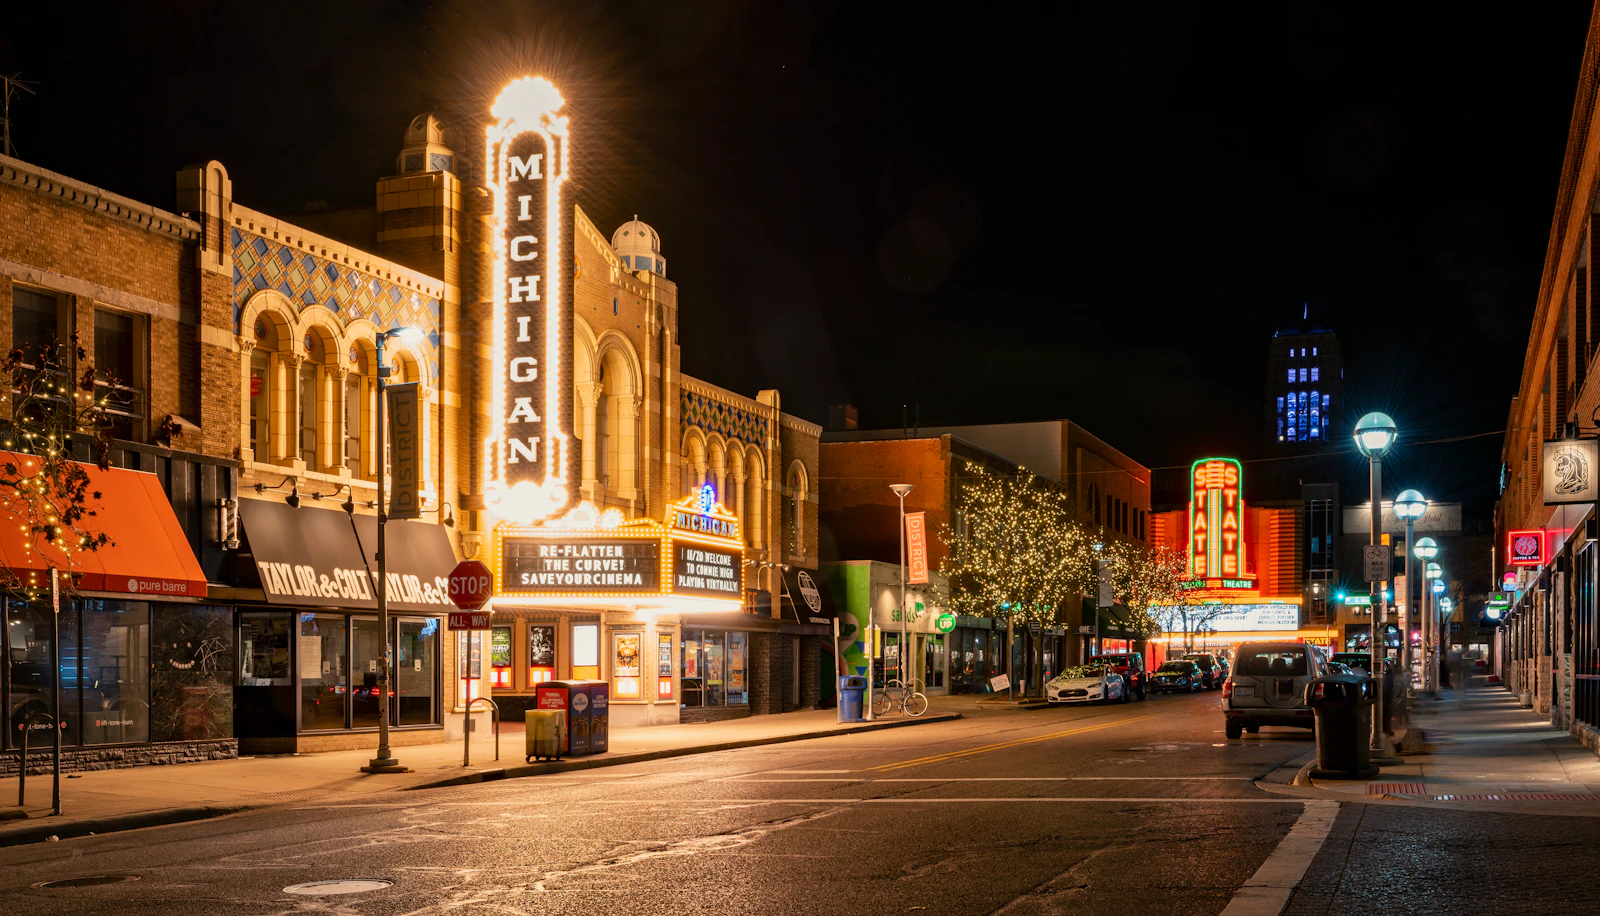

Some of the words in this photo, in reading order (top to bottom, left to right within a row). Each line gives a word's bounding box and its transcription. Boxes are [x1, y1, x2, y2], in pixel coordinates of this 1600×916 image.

[508, 154, 543, 464] MICHIGAN
[396, 397, 412, 506] DISTRICT
[676, 512, 735, 538] MICHIGAN
[1195, 468, 1206, 573] STATE
[1224, 467, 1237, 572] STATE
[540, 545, 624, 557] RE-FLATTEN
[910, 519, 924, 577] DISTRICT
[545, 559, 569, 571] THE
[575, 559, 624, 571] CURVE!
[705, 551, 731, 565] WELCOME
[686, 563, 694, 574] TO
[696, 564, 718, 577] CONNIE
[720, 567, 734, 579] HIGH
[139, 581, 160, 593] pure
[162, 580, 186, 592] barre
[258, 561, 372, 600] TAYLOR&COLT
[451, 576, 489, 595] STOP
[522, 573, 642, 585] SAVEYOURCINEMA
[678, 575, 704, 588] PLAYING
[1223, 580, 1252, 588] THEATRE
[450, 615, 465, 627] ALL
[471, 615, 488, 626] WAY
[940, 621, 953, 629] UP
